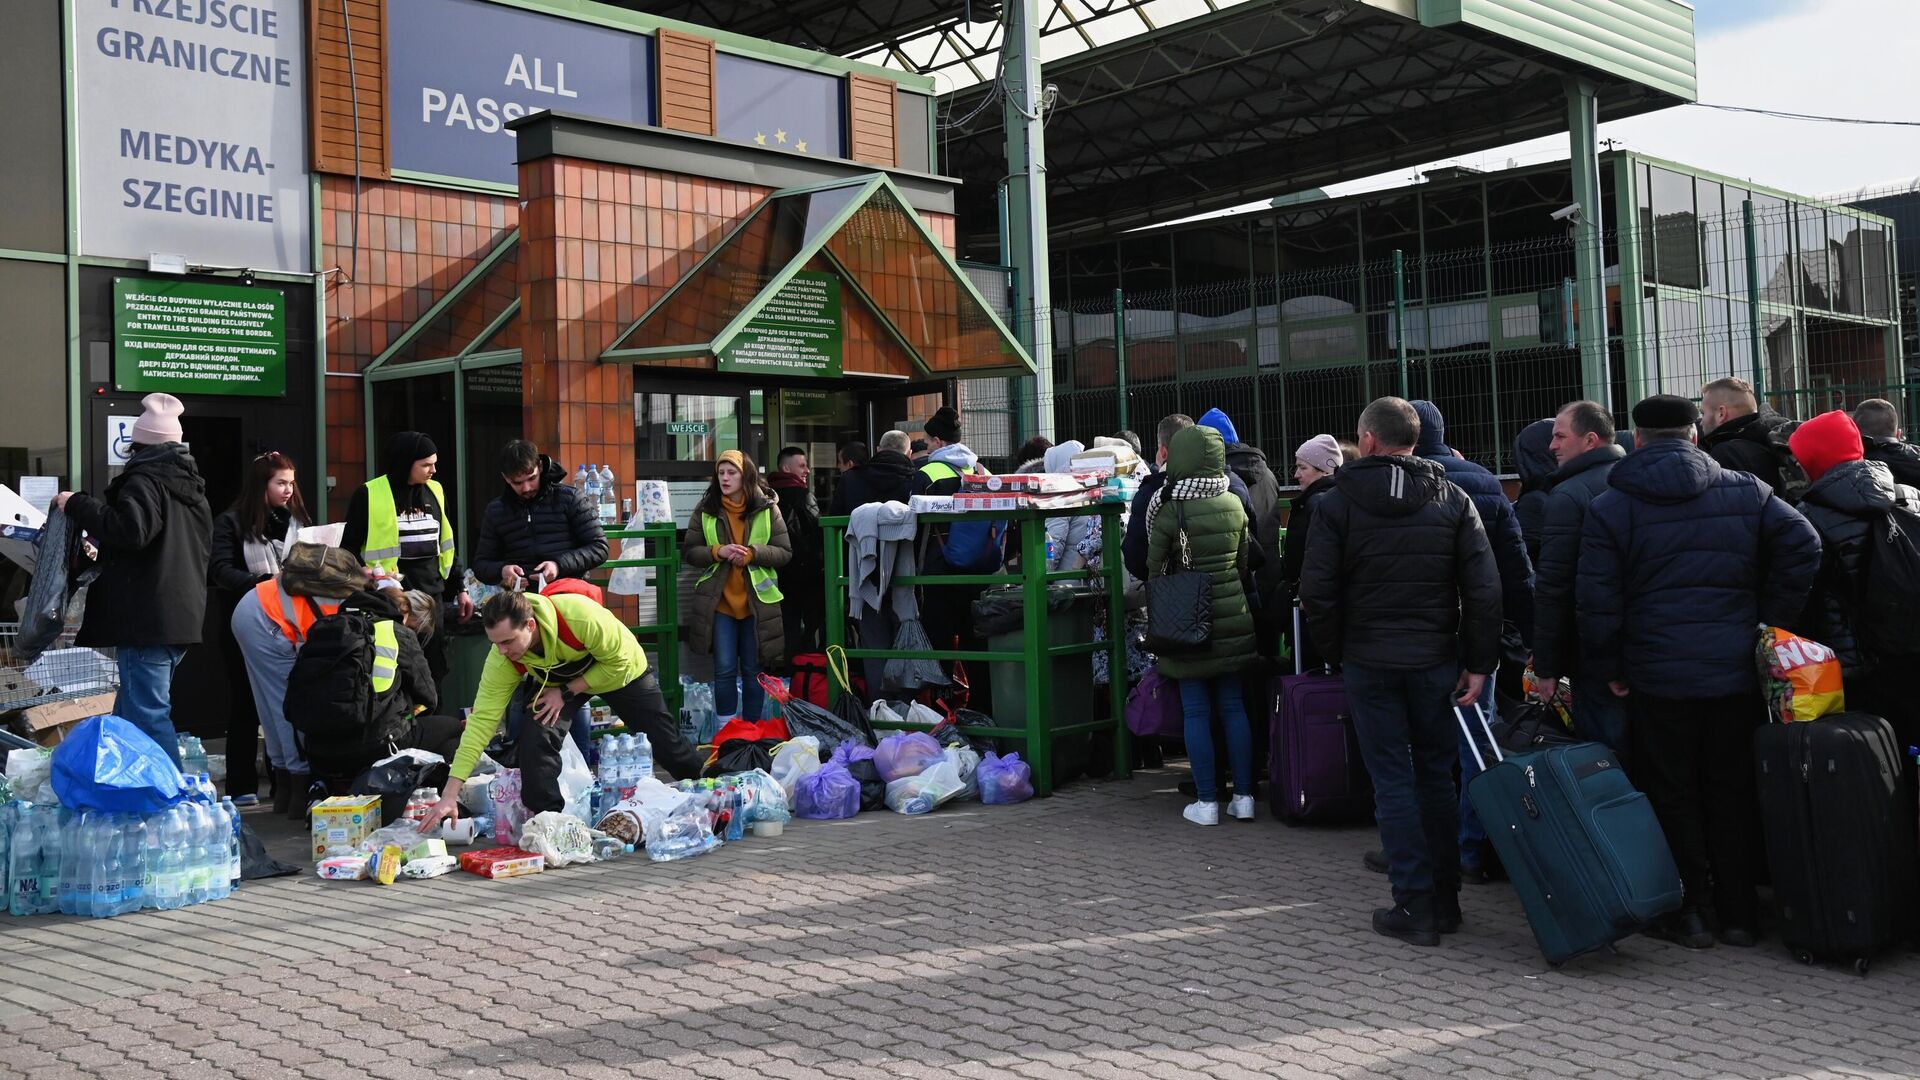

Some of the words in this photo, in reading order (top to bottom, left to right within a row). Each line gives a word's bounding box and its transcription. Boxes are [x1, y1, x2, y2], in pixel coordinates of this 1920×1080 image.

[96, 26, 291, 87] GRANICZNE
[504, 53, 578, 98] ALL
[422, 87, 551, 138] PASS
[120, 128, 275, 176] MEDYKA-
[122, 178, 274, 223] SZEGINIE
[125, 293, 156, 302] WEJŚCIE
[169, 297, 202, 305] BUDYNKU
[203, 299, 242, 309] WYŁĄCZNIE
[257, 302, 274, 310] OSÓB
[126, 303, 198, 315] PRZEKRACZAJĄCYCH
[200, 309, 229, 317] GRANICĘ
[138, 313, 160, 321] ENTRY
[188, 316, 220, 325] BUILDING
[221, 318, 265, 328] EXCLUSIVELY
[143, 323, 189, 332] TRAWELLERS
[208, 327, 230, 335] CROSS
[231, 328, 244, 336] THE
[245, 329, 274, 337] BORDER.
[125, 341, 142, 349] ВХІД
[144, 342, 181, 350] ВІКЛЮЧНО
[228, 346, 276, 355] ПЕРЕТИНАЮТЬ
[165, 352, 210, 361] ДЕРЖАВНИЙ
[162, 361, 189, 370] БУДУТЬ
[143, 370, 193, 379] НАТИСНЕТЬСЯ
[194, 372, 221, 380] КНОПКУ
[671, 423, 705, 433] WEJŚCIE
